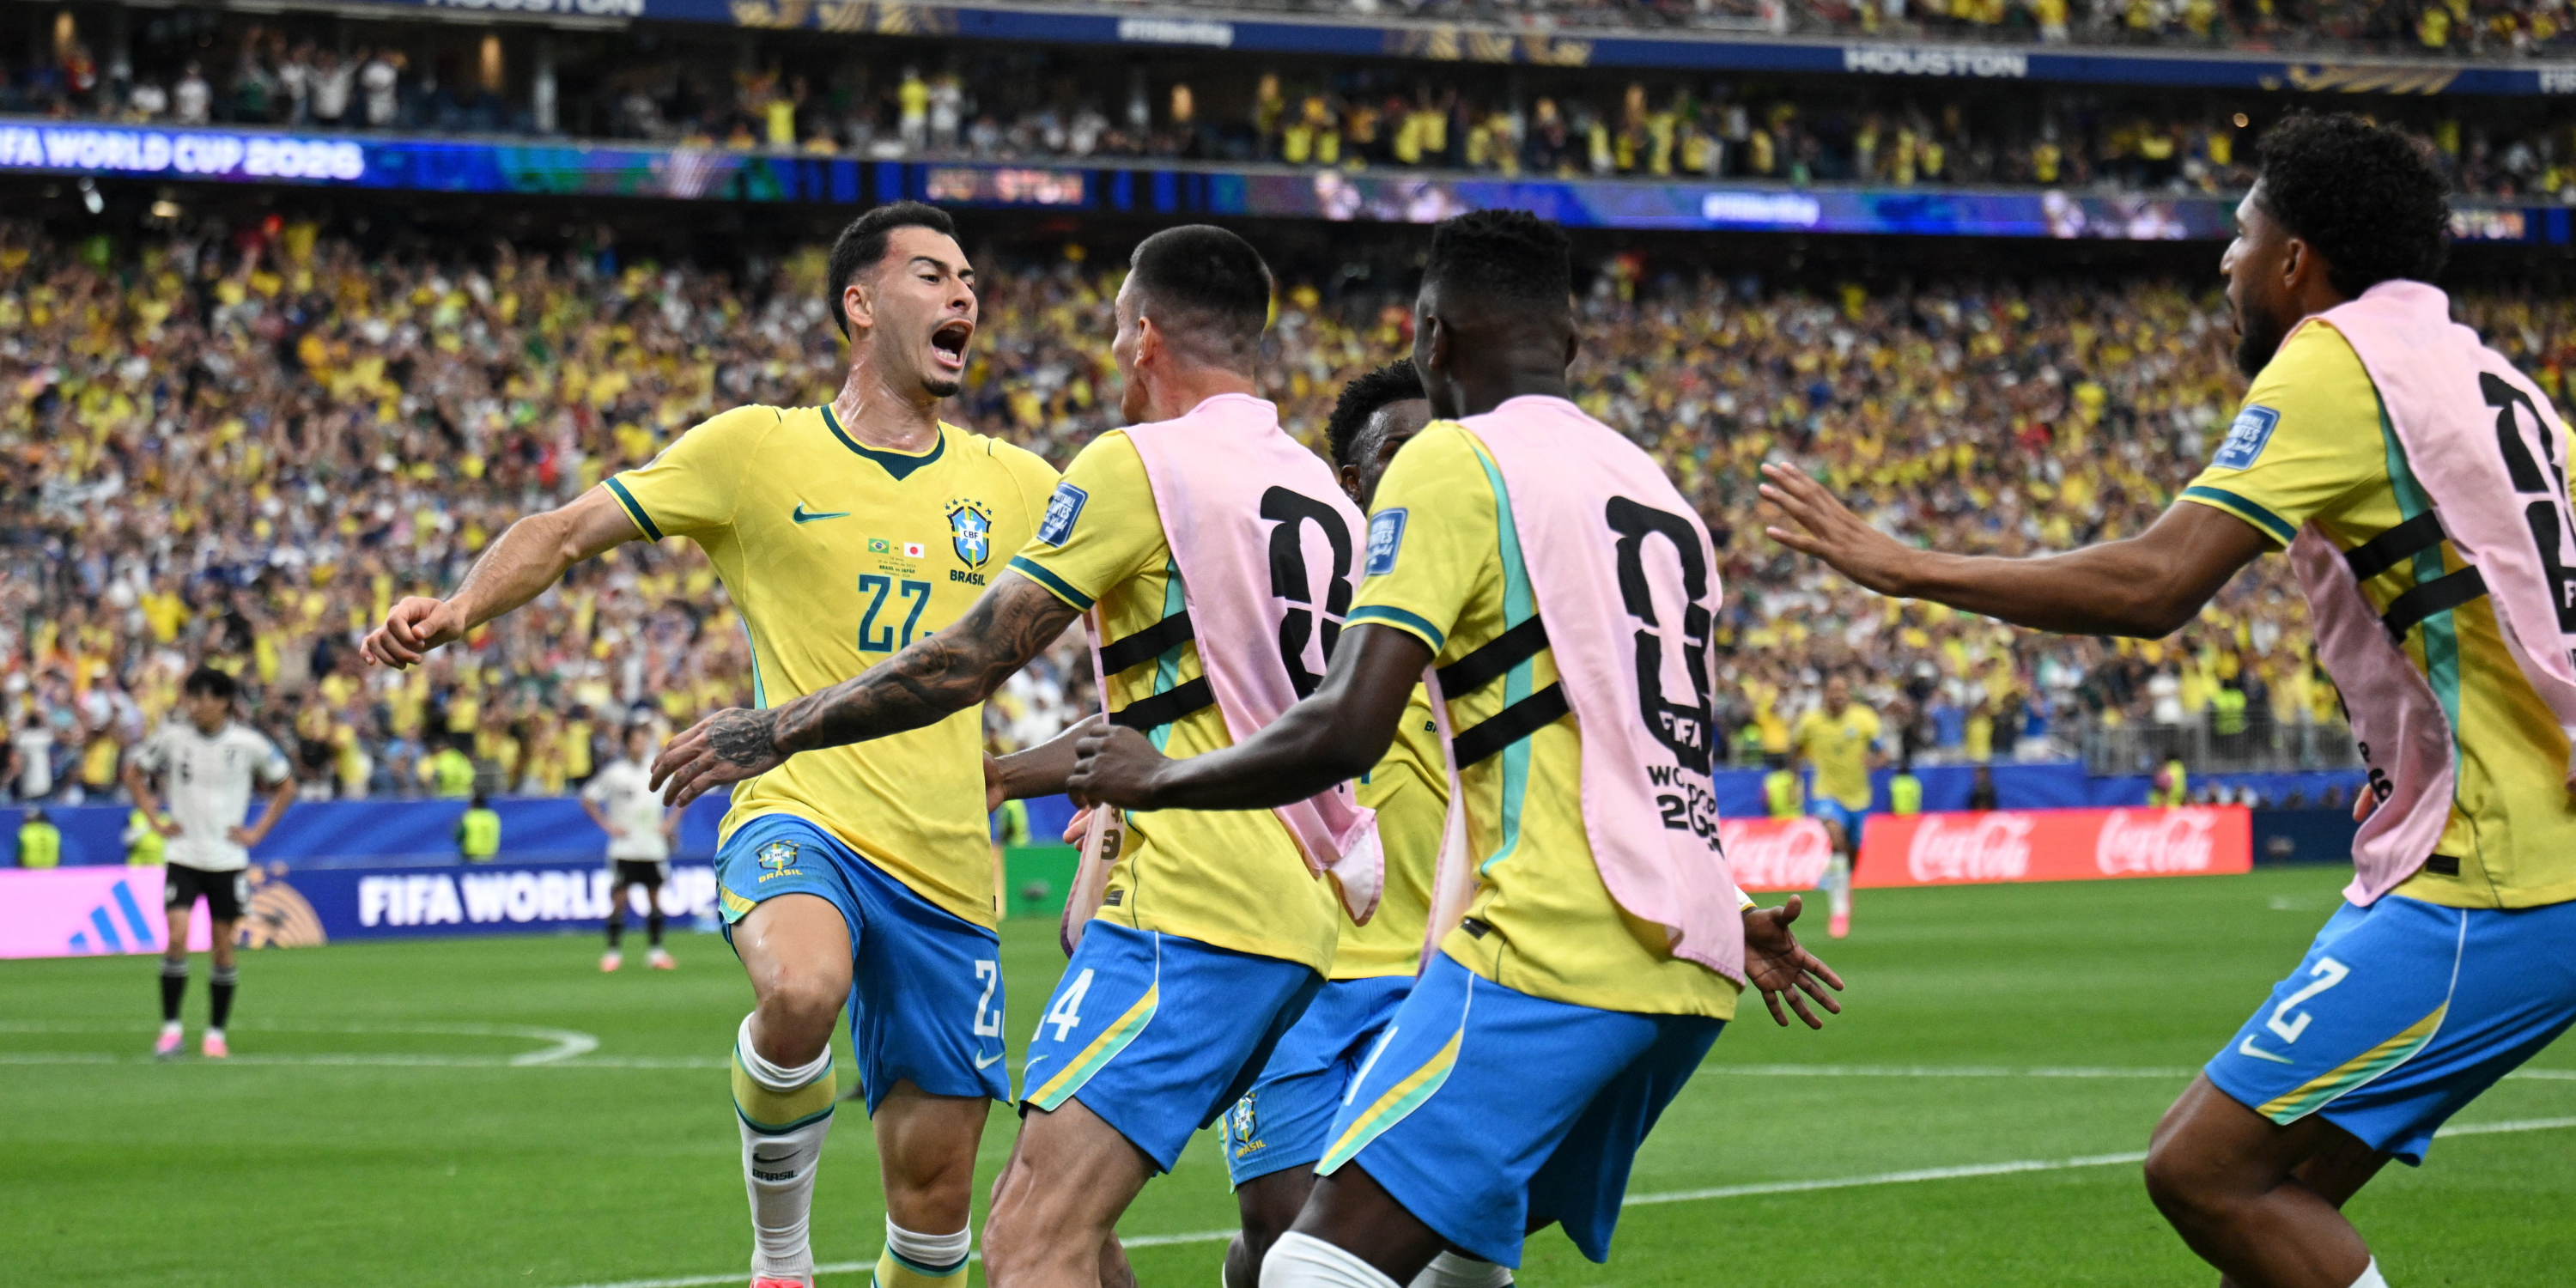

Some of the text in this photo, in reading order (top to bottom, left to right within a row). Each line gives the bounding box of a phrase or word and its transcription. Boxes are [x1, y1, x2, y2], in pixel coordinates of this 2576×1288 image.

[1844, 50, 2027, 77] HOUSTON
[46, 129, 172, 171] WORLD
[173, 134, 244, 173] CUP
[246, 138, 365, 180] 2026
[963, 530, 979, 540] CBF
[950, 569, 986, 586] BRASIL
[859, 574, 933, 653] 22
[1908, 811, 2037, 882] Coca-Cola
[2094, 806, 2219, 876] Coca-Cola
[758, 869, 803, 884] BRASIL
[359, 874, 461, 927] FIFA
[461, 869, 615, 921] WORLD
[2266, 956, 2350, 1044] 2
[1236, 1139, 1267, 1158] BRASIL
[752, 1168, 798, 1182] BRASIL
